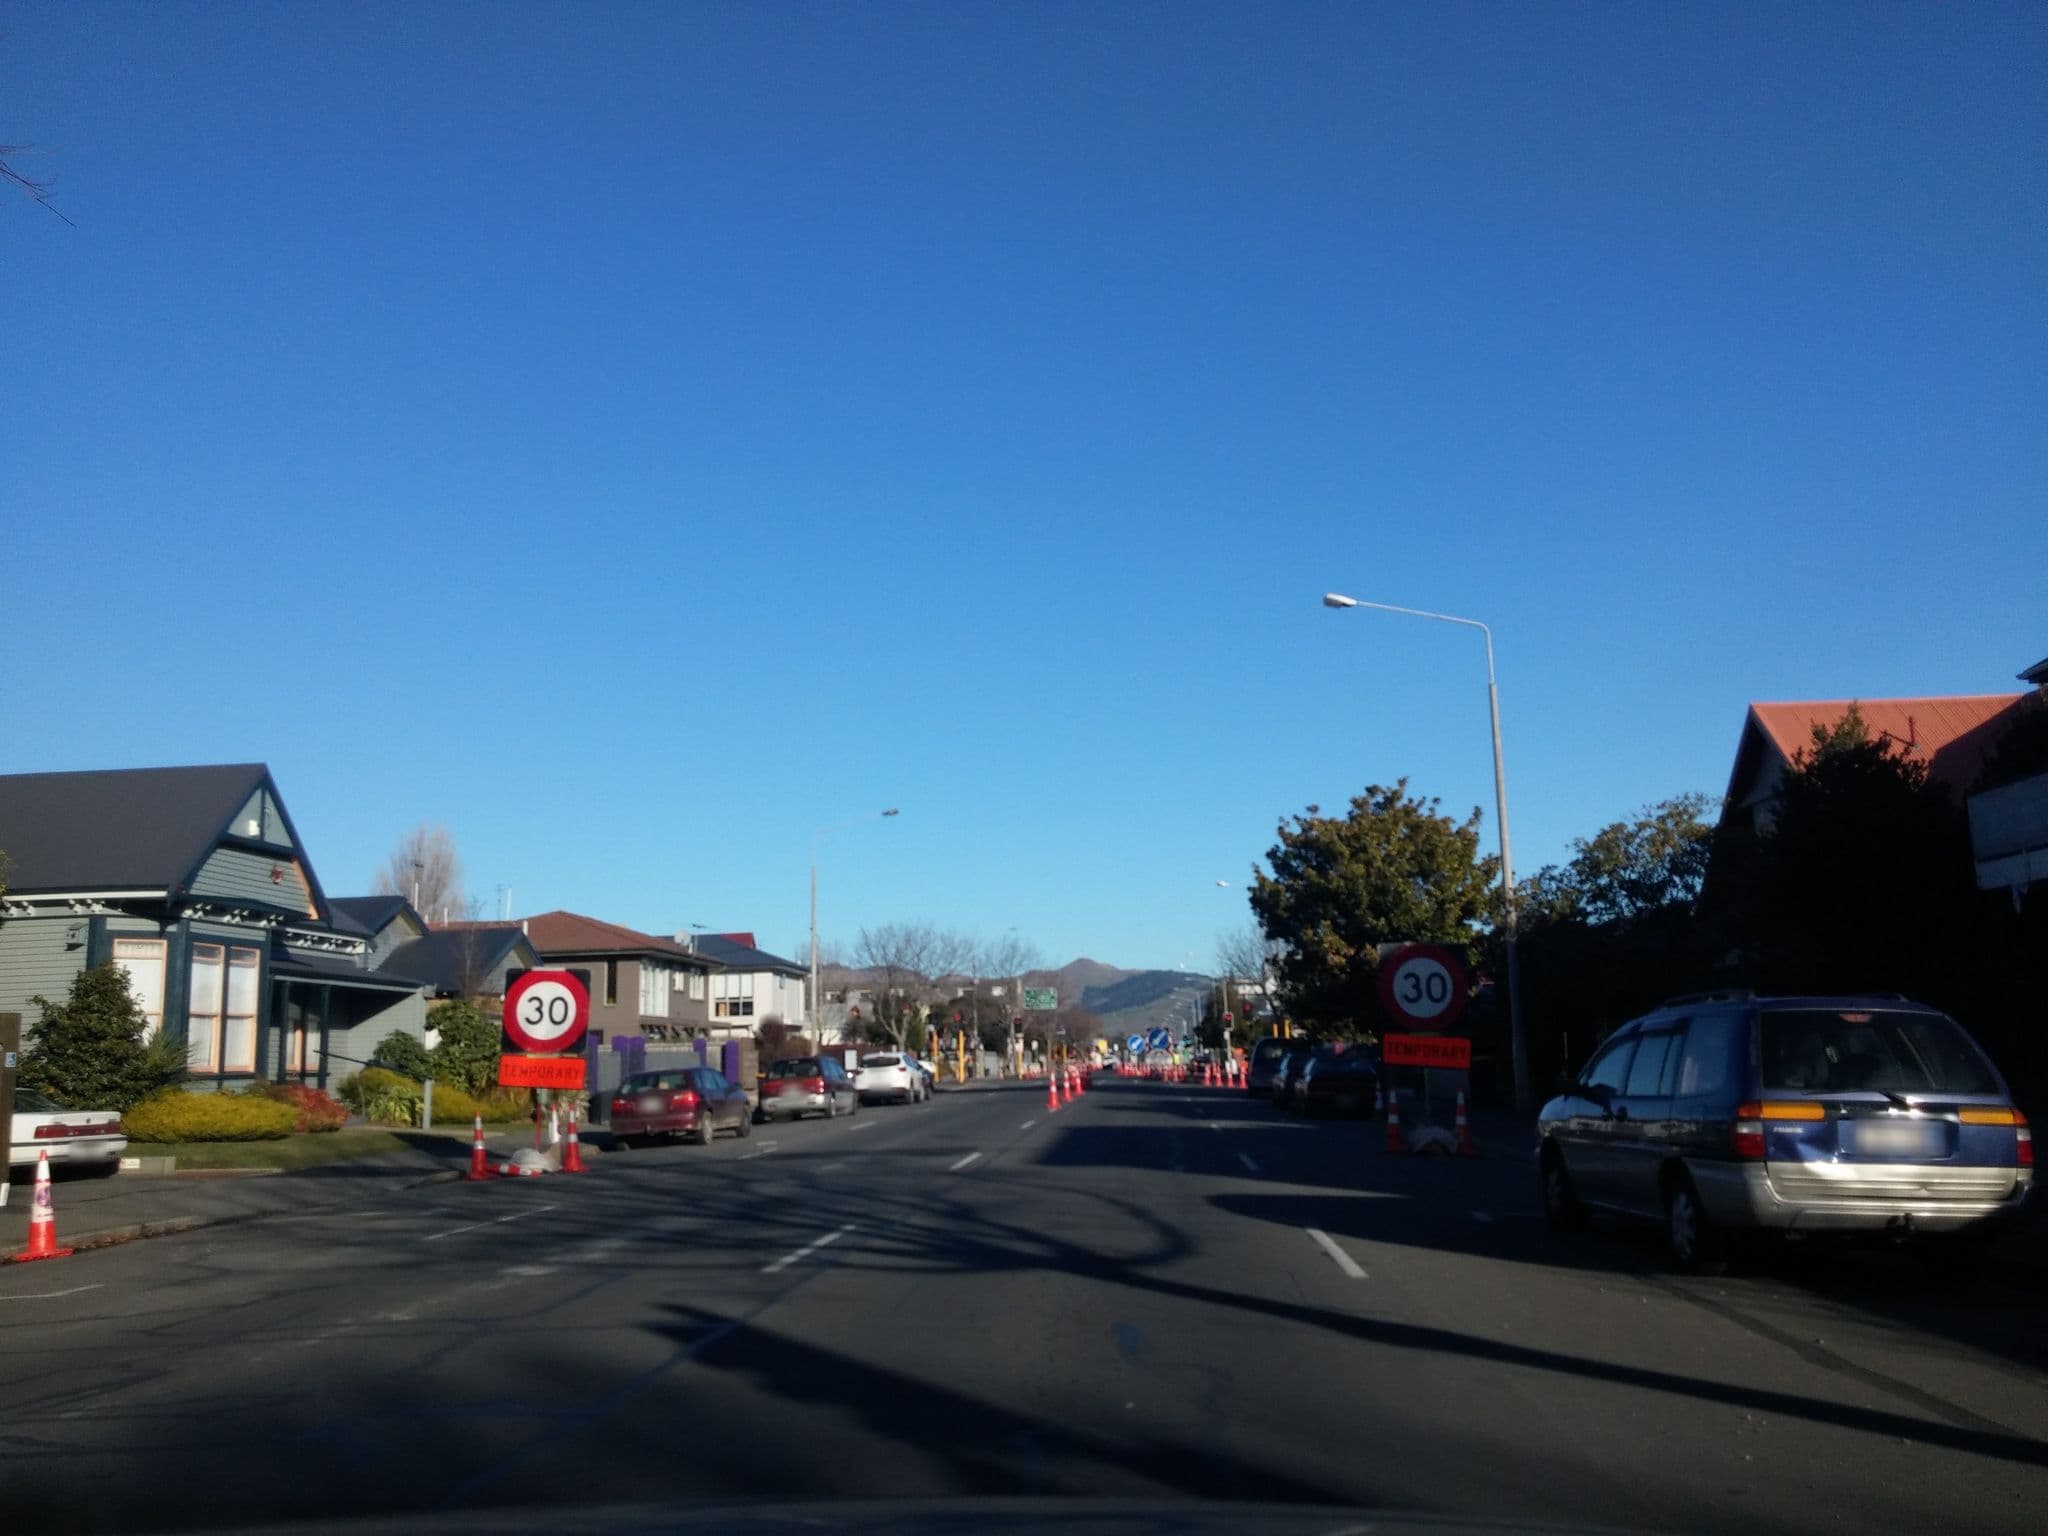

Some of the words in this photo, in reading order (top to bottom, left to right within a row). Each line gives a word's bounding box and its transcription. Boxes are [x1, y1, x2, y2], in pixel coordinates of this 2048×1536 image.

[1402, 971, 1448, 1005] 30
[525, 996, 568, 1026] 30
[1387, 1040, 1467, 1059] TEMPORARY
[504, 1064, 580, 1081] TEMPORARY
